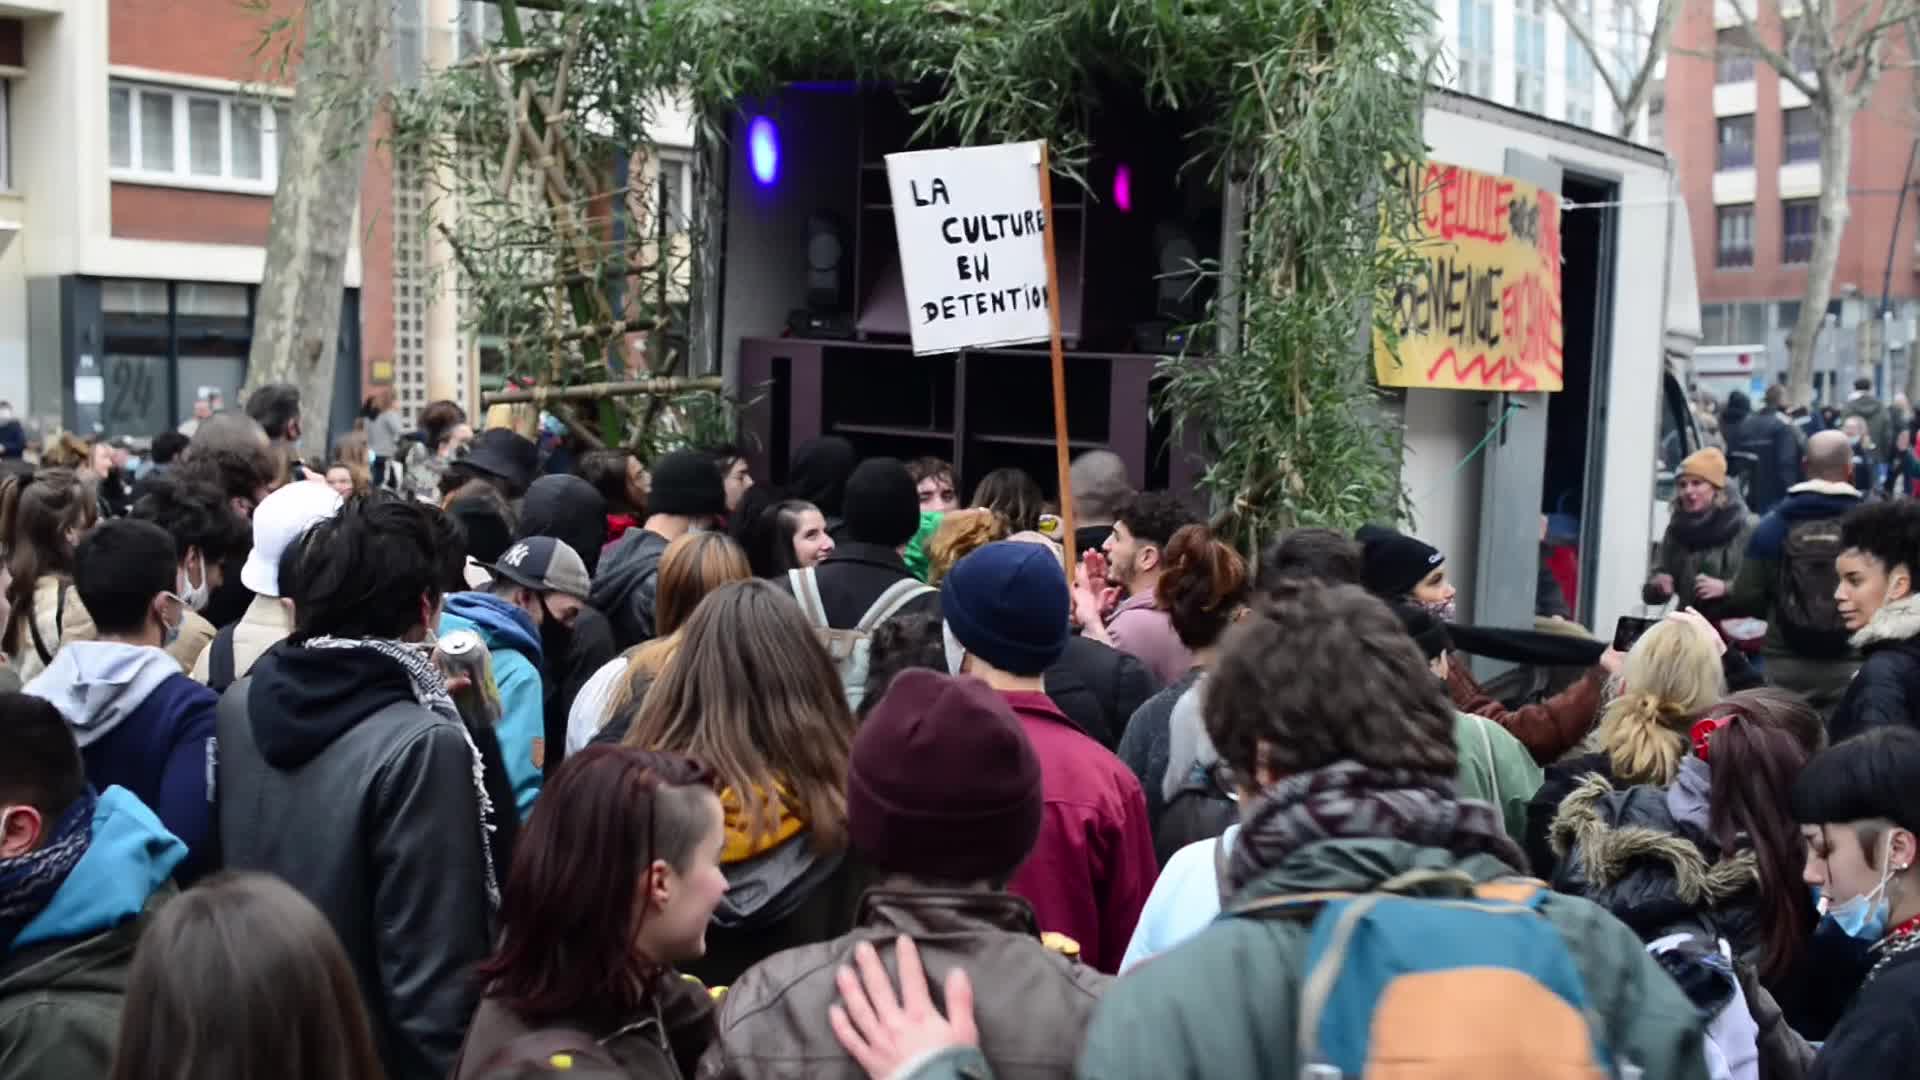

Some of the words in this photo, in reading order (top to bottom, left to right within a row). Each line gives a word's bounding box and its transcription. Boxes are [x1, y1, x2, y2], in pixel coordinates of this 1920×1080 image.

[911, 178, 951, 207] LA
[942, 209, 1045, 244] CULTURE
[957, 252, 989, 282] EN
